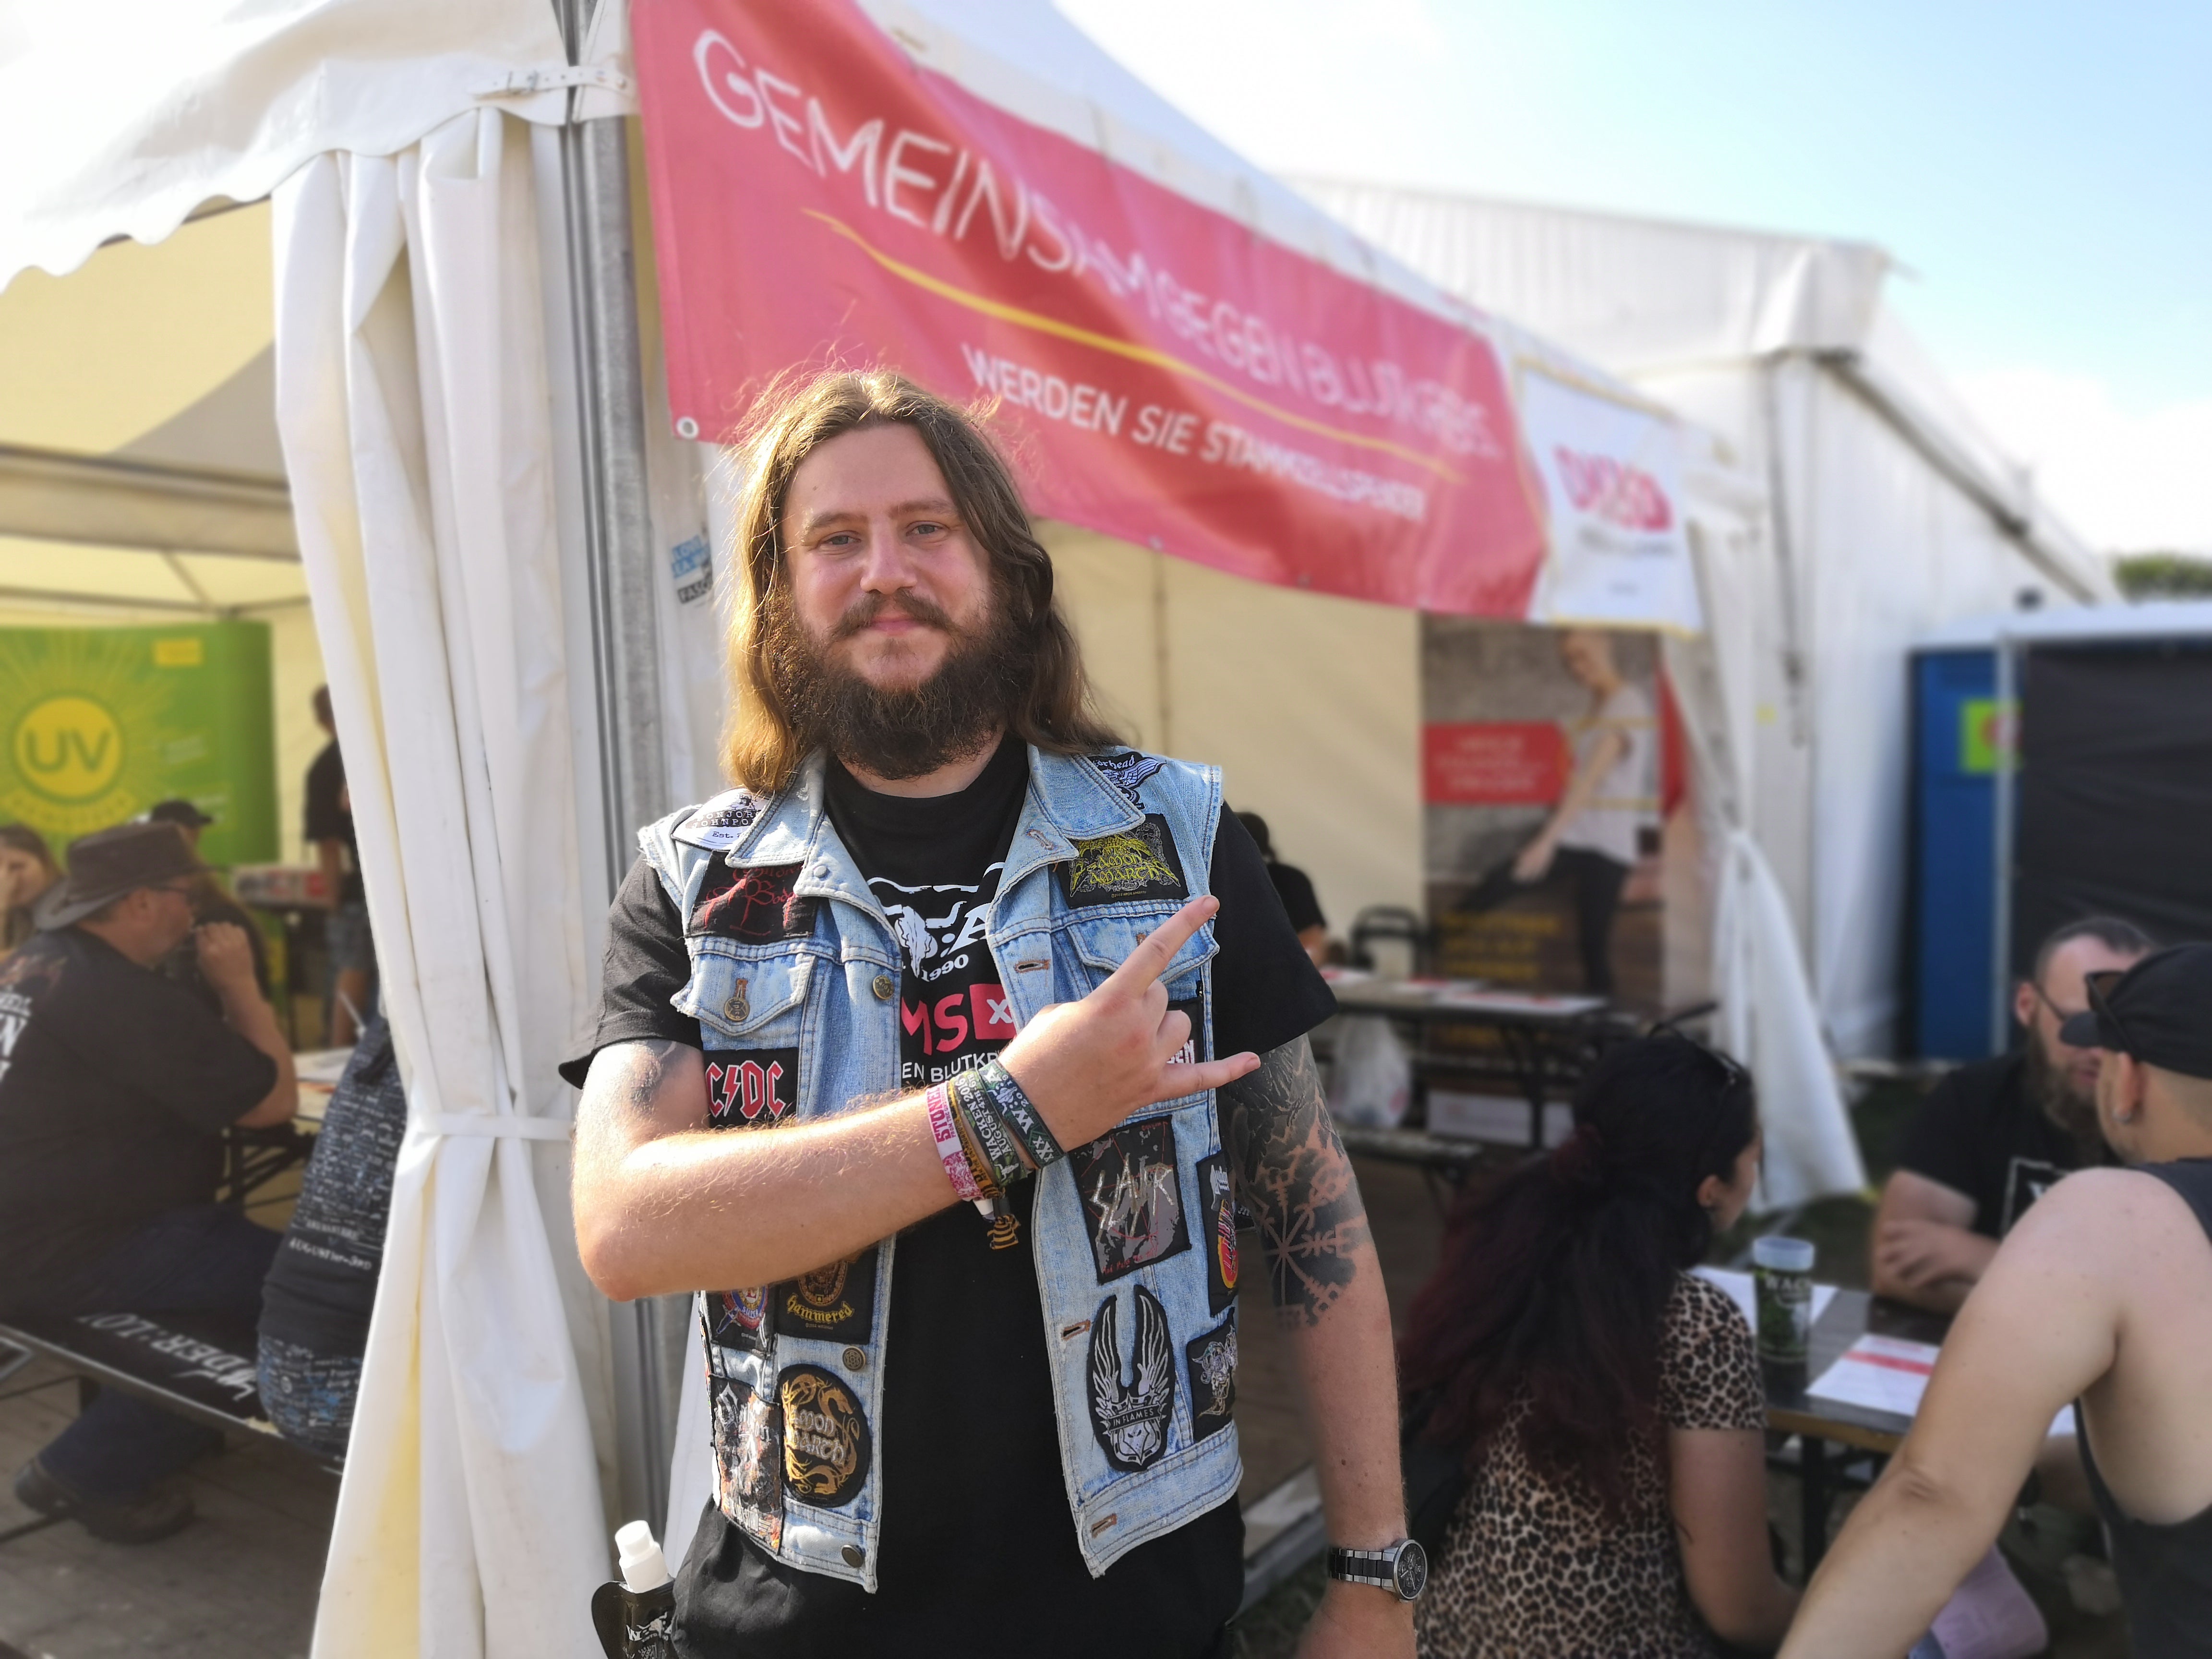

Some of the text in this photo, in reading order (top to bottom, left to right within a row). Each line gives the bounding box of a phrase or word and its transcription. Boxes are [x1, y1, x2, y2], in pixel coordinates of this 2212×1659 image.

[962, 343, 1129, 435] WERDEN
[1131, 405, 1199, 457] SIE
[24, 727, 111, 775] UV
[920, 954, 969, 982] 1990
[967, 1101, 1002, 1161] WACKEN
[982, 1108, 1012, 1153] AUGUST
[1113, 1408, 1154, 1427] IN FLAMES
